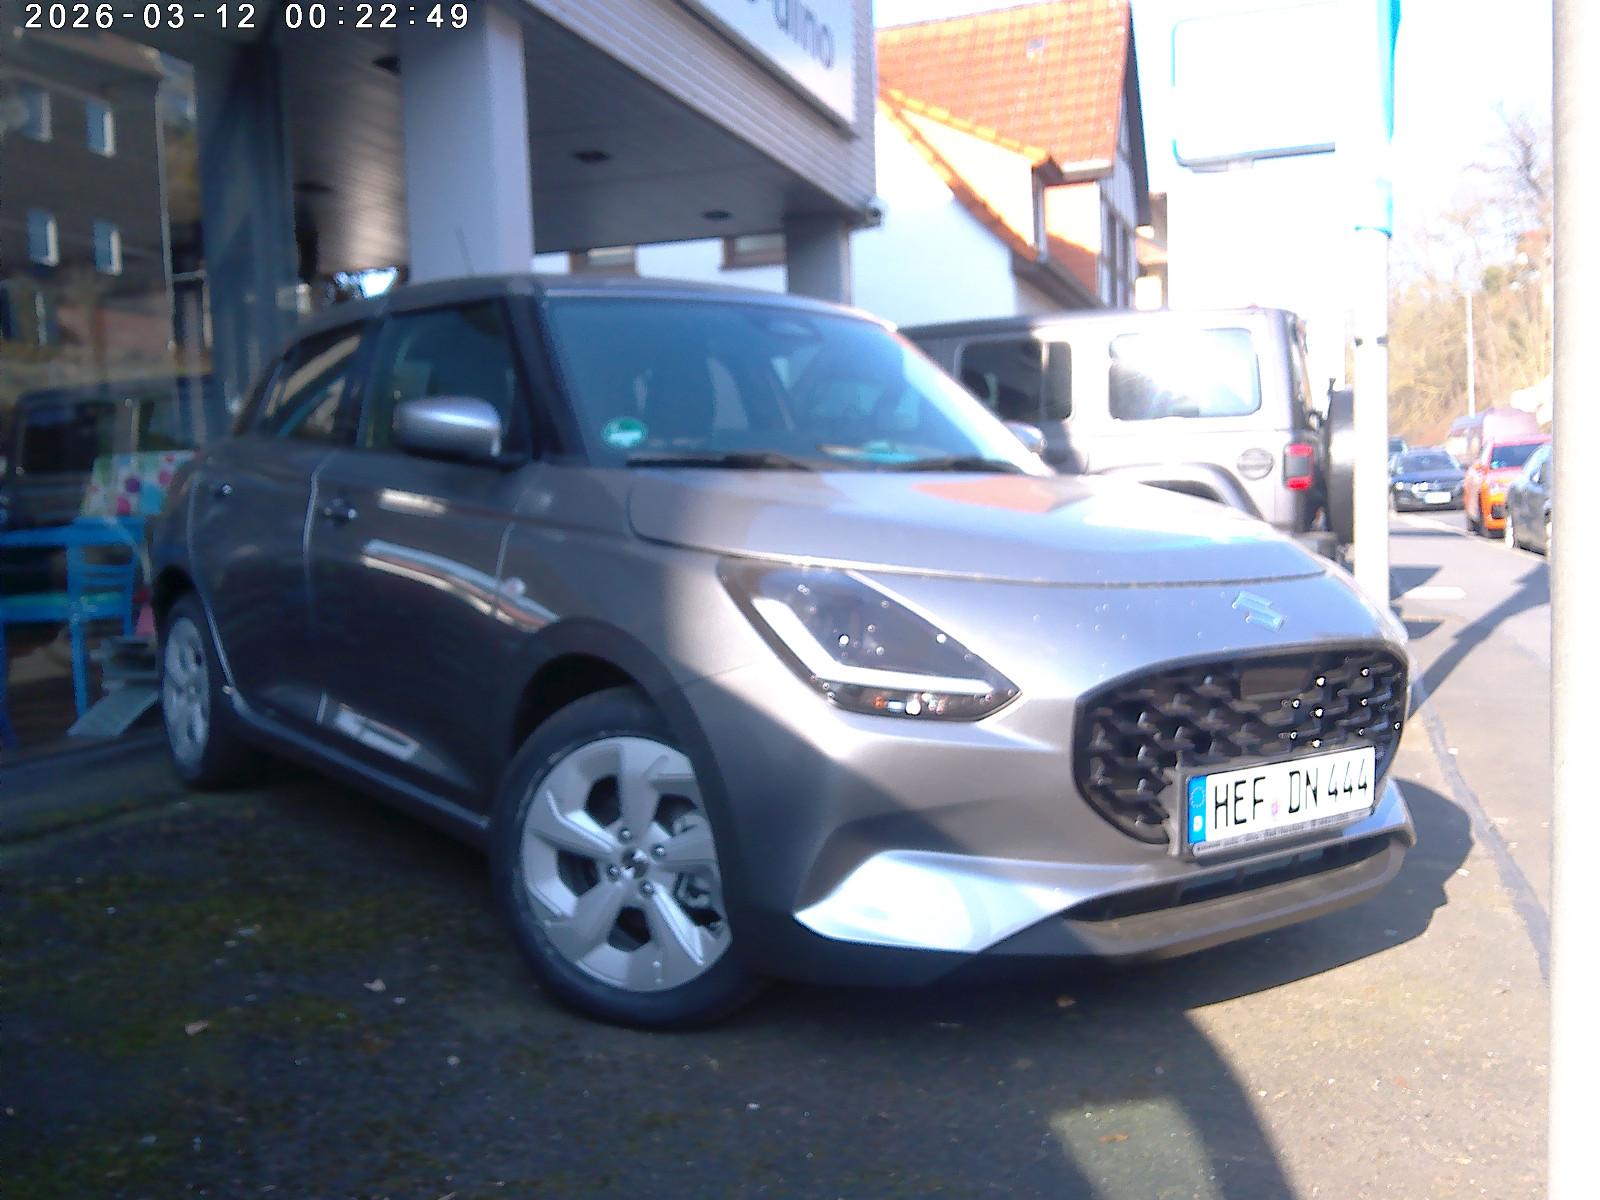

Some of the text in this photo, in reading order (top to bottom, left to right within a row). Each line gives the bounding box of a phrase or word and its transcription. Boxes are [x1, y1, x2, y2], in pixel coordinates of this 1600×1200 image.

[1214, 758, 1368, 830] HEF DN 444
